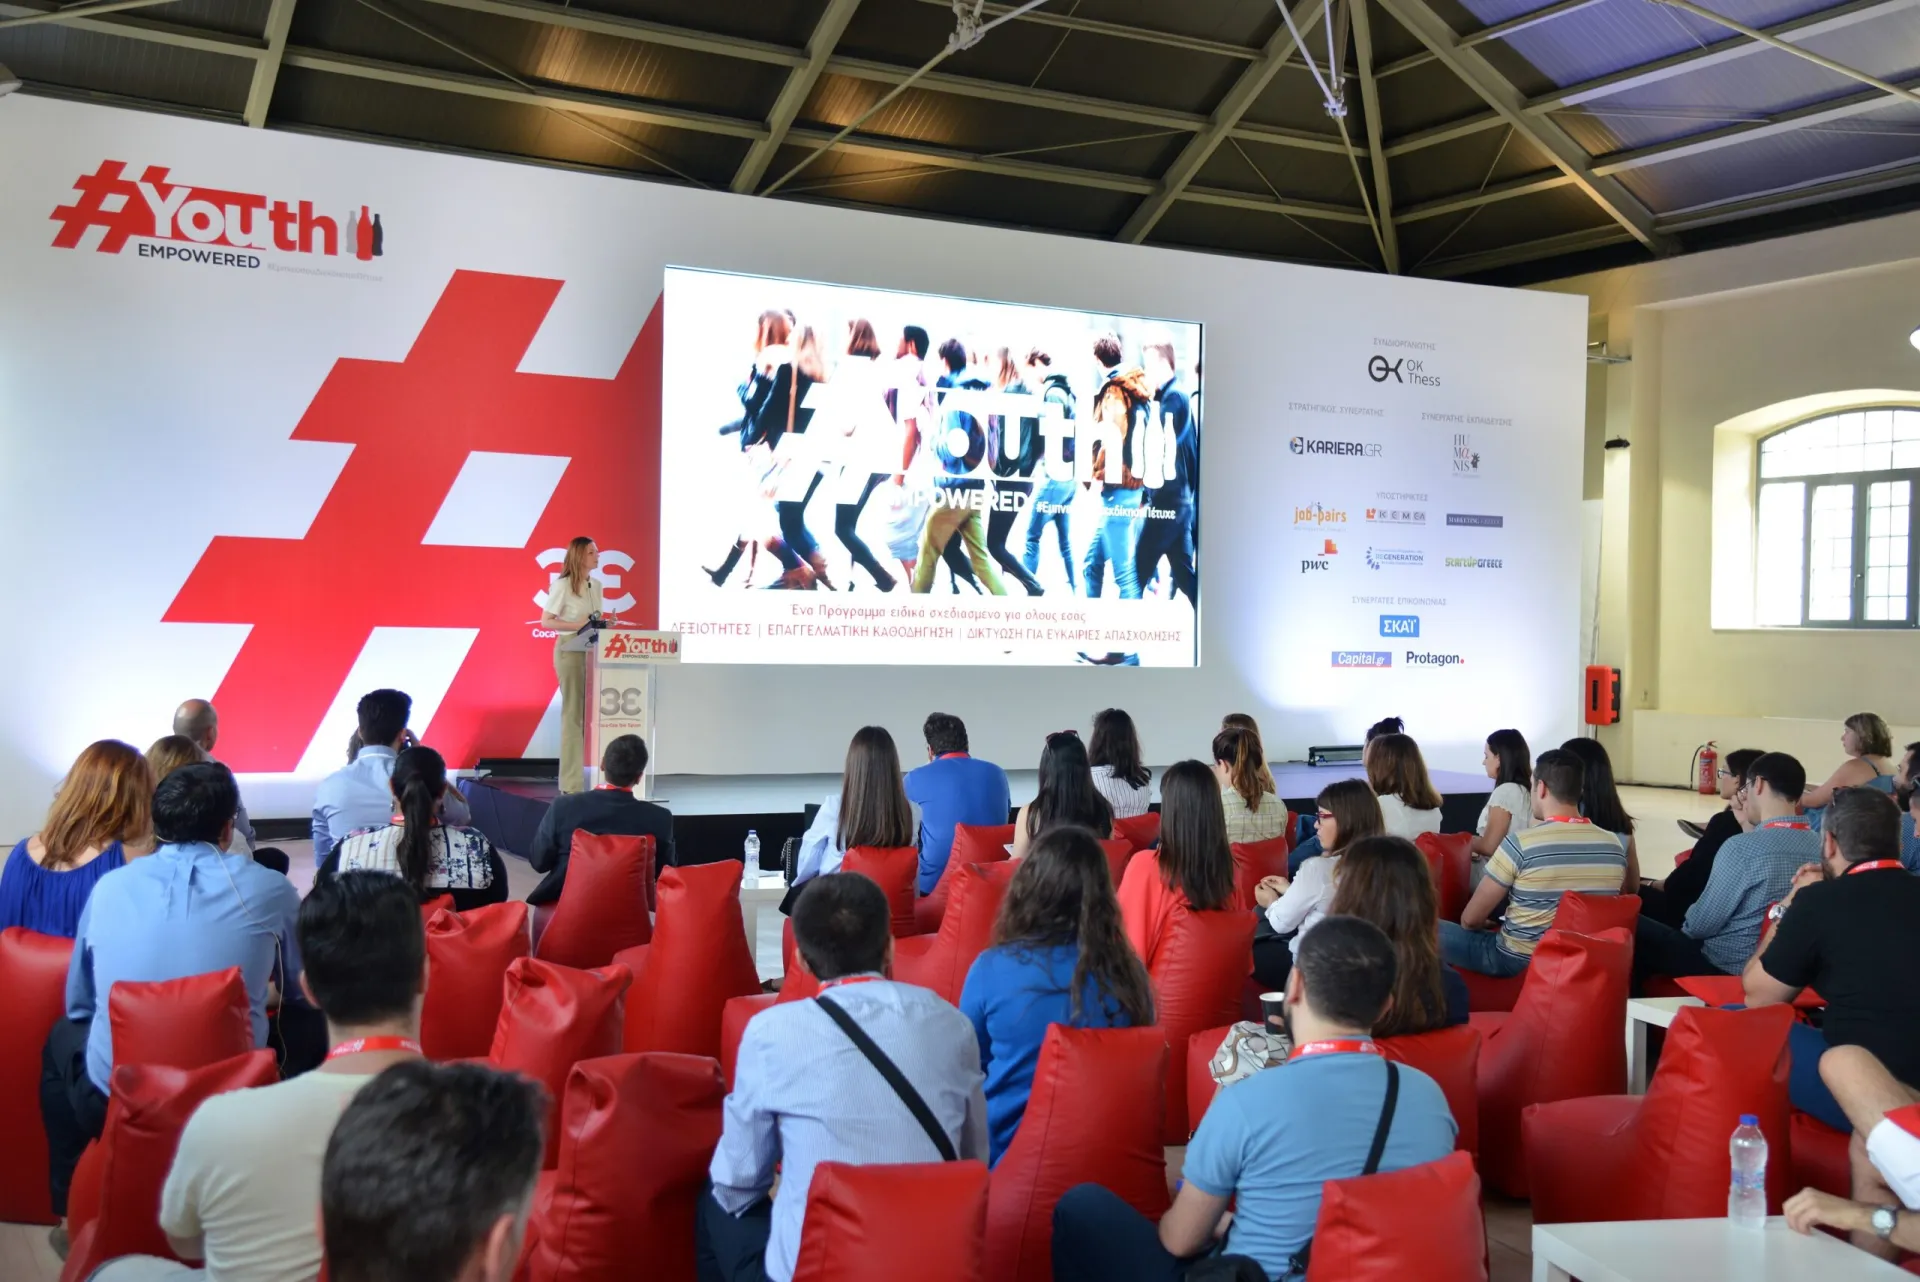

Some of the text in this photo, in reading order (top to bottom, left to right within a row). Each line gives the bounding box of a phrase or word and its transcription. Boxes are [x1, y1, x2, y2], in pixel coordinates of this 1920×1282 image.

[138, 243, 260, 269] EMPOWERED
[1406, 359, 1424, 372] OK
[1408, 373, 1441, 387] Thess
[1306, 440, 1383, 457] KARIERA.GR
[1294, 506, 1347, 525] job-pairs
[1301, 559, 1329, 573] pwc
[1004, 613, 1022, 621] για
[768, 624, 868, 637] ΕΠΑΓΓΕΛΜΑΤΙΚΗ
[873, 626, 953, 638] ΚΑΘΟΔΗΓΗΣΗ
[967, 627, 1023, 639] ΔΙΚΤΥΩΣΗ
[1026, 628, 1044, 640] ΓΙΑ
[1047, 629, 1100, 640] ΕΥΚΑΙΡΙΕΣ
[1104, 630, 1182, 642] ΑΠΑΣΧΟΛΗΣΗΣ
